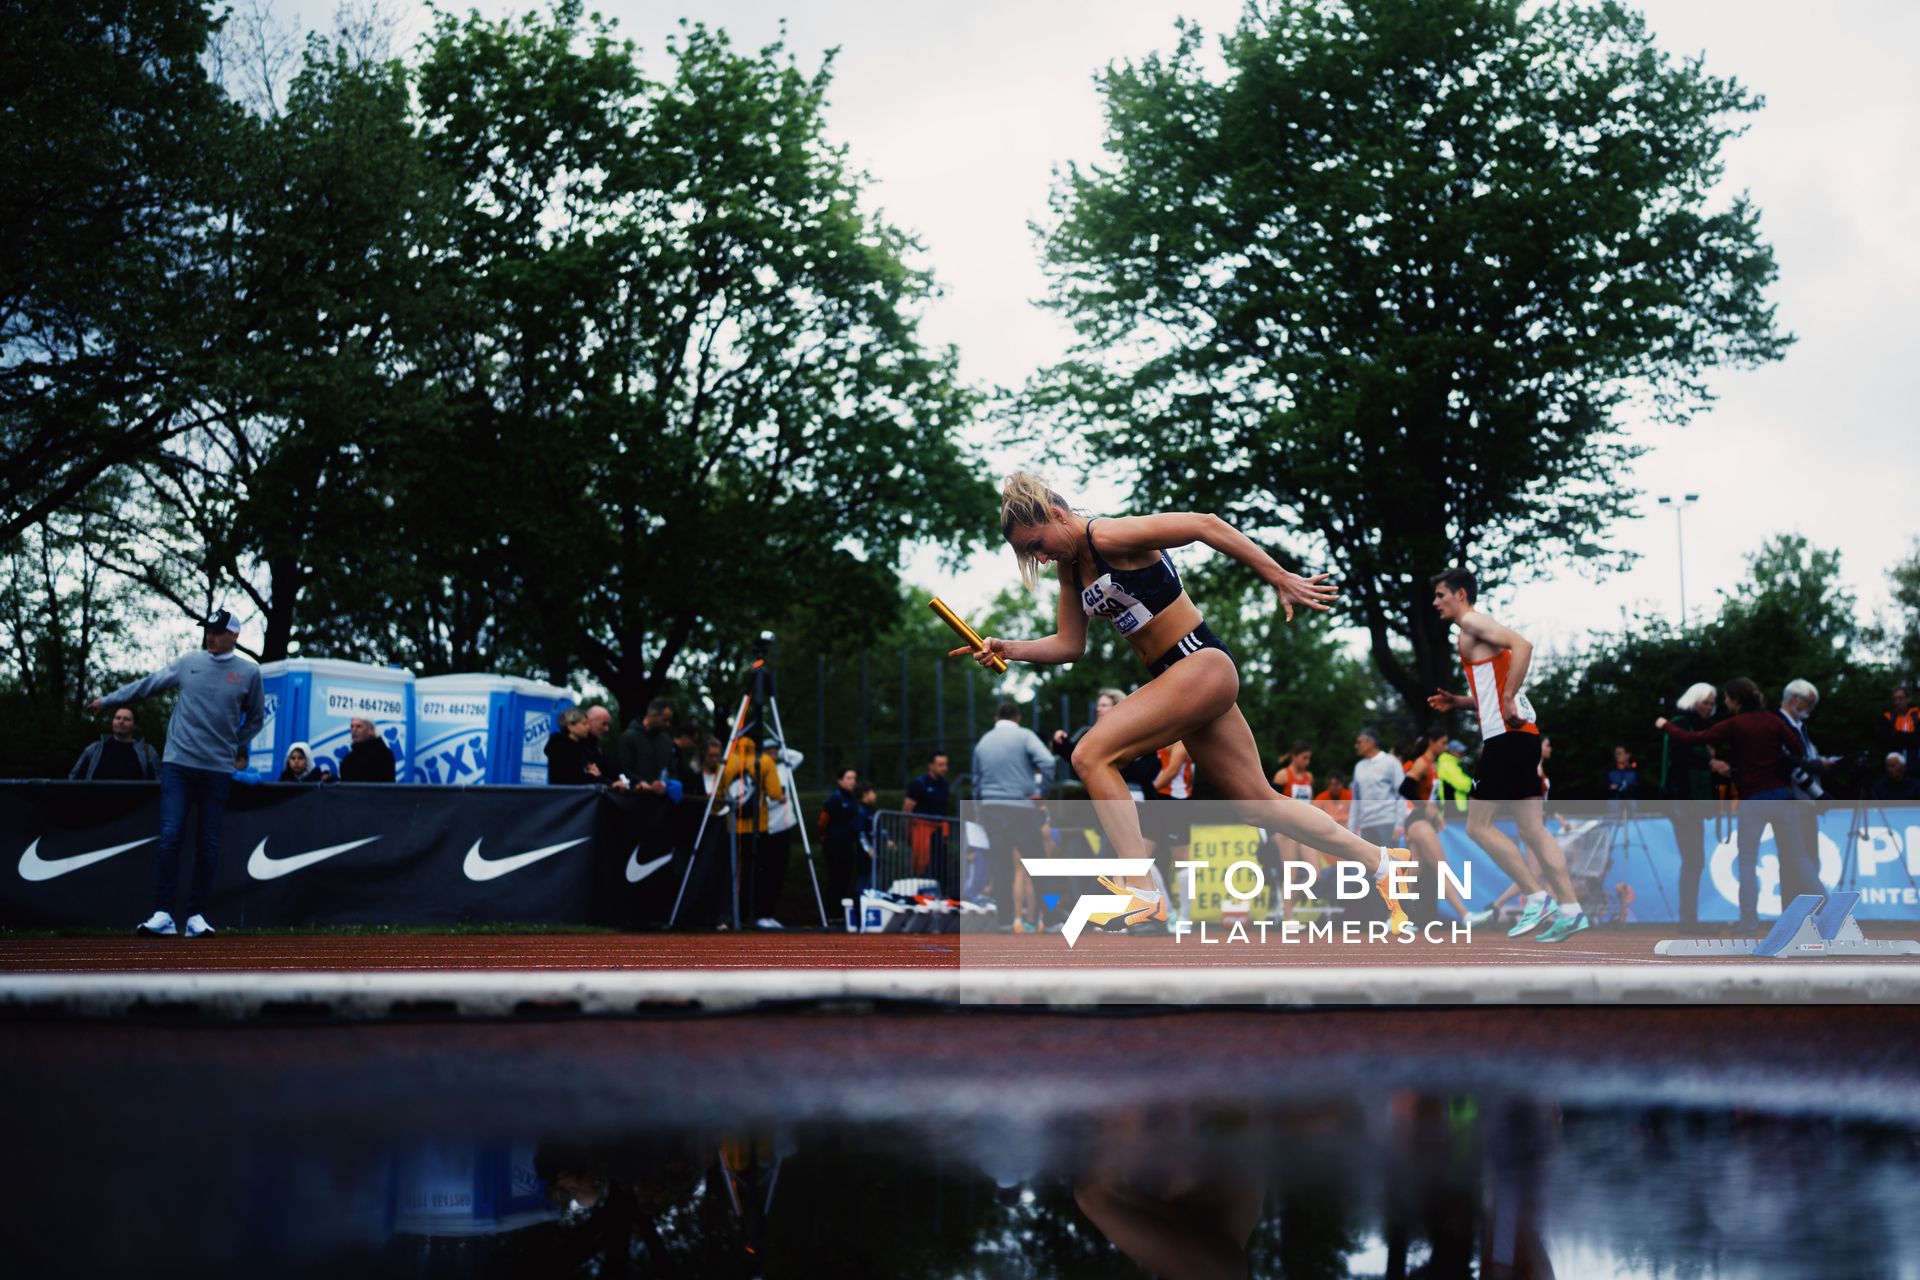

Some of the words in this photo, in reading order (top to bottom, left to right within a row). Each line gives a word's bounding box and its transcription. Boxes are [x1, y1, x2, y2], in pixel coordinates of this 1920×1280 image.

[1084, 583, 1104, 607] GLS
[329, 694, 401, 714] 0721-4647260
[423, 702, 487, 716] 0721-4647260
[1860, 887, 1920, 905] INTE
